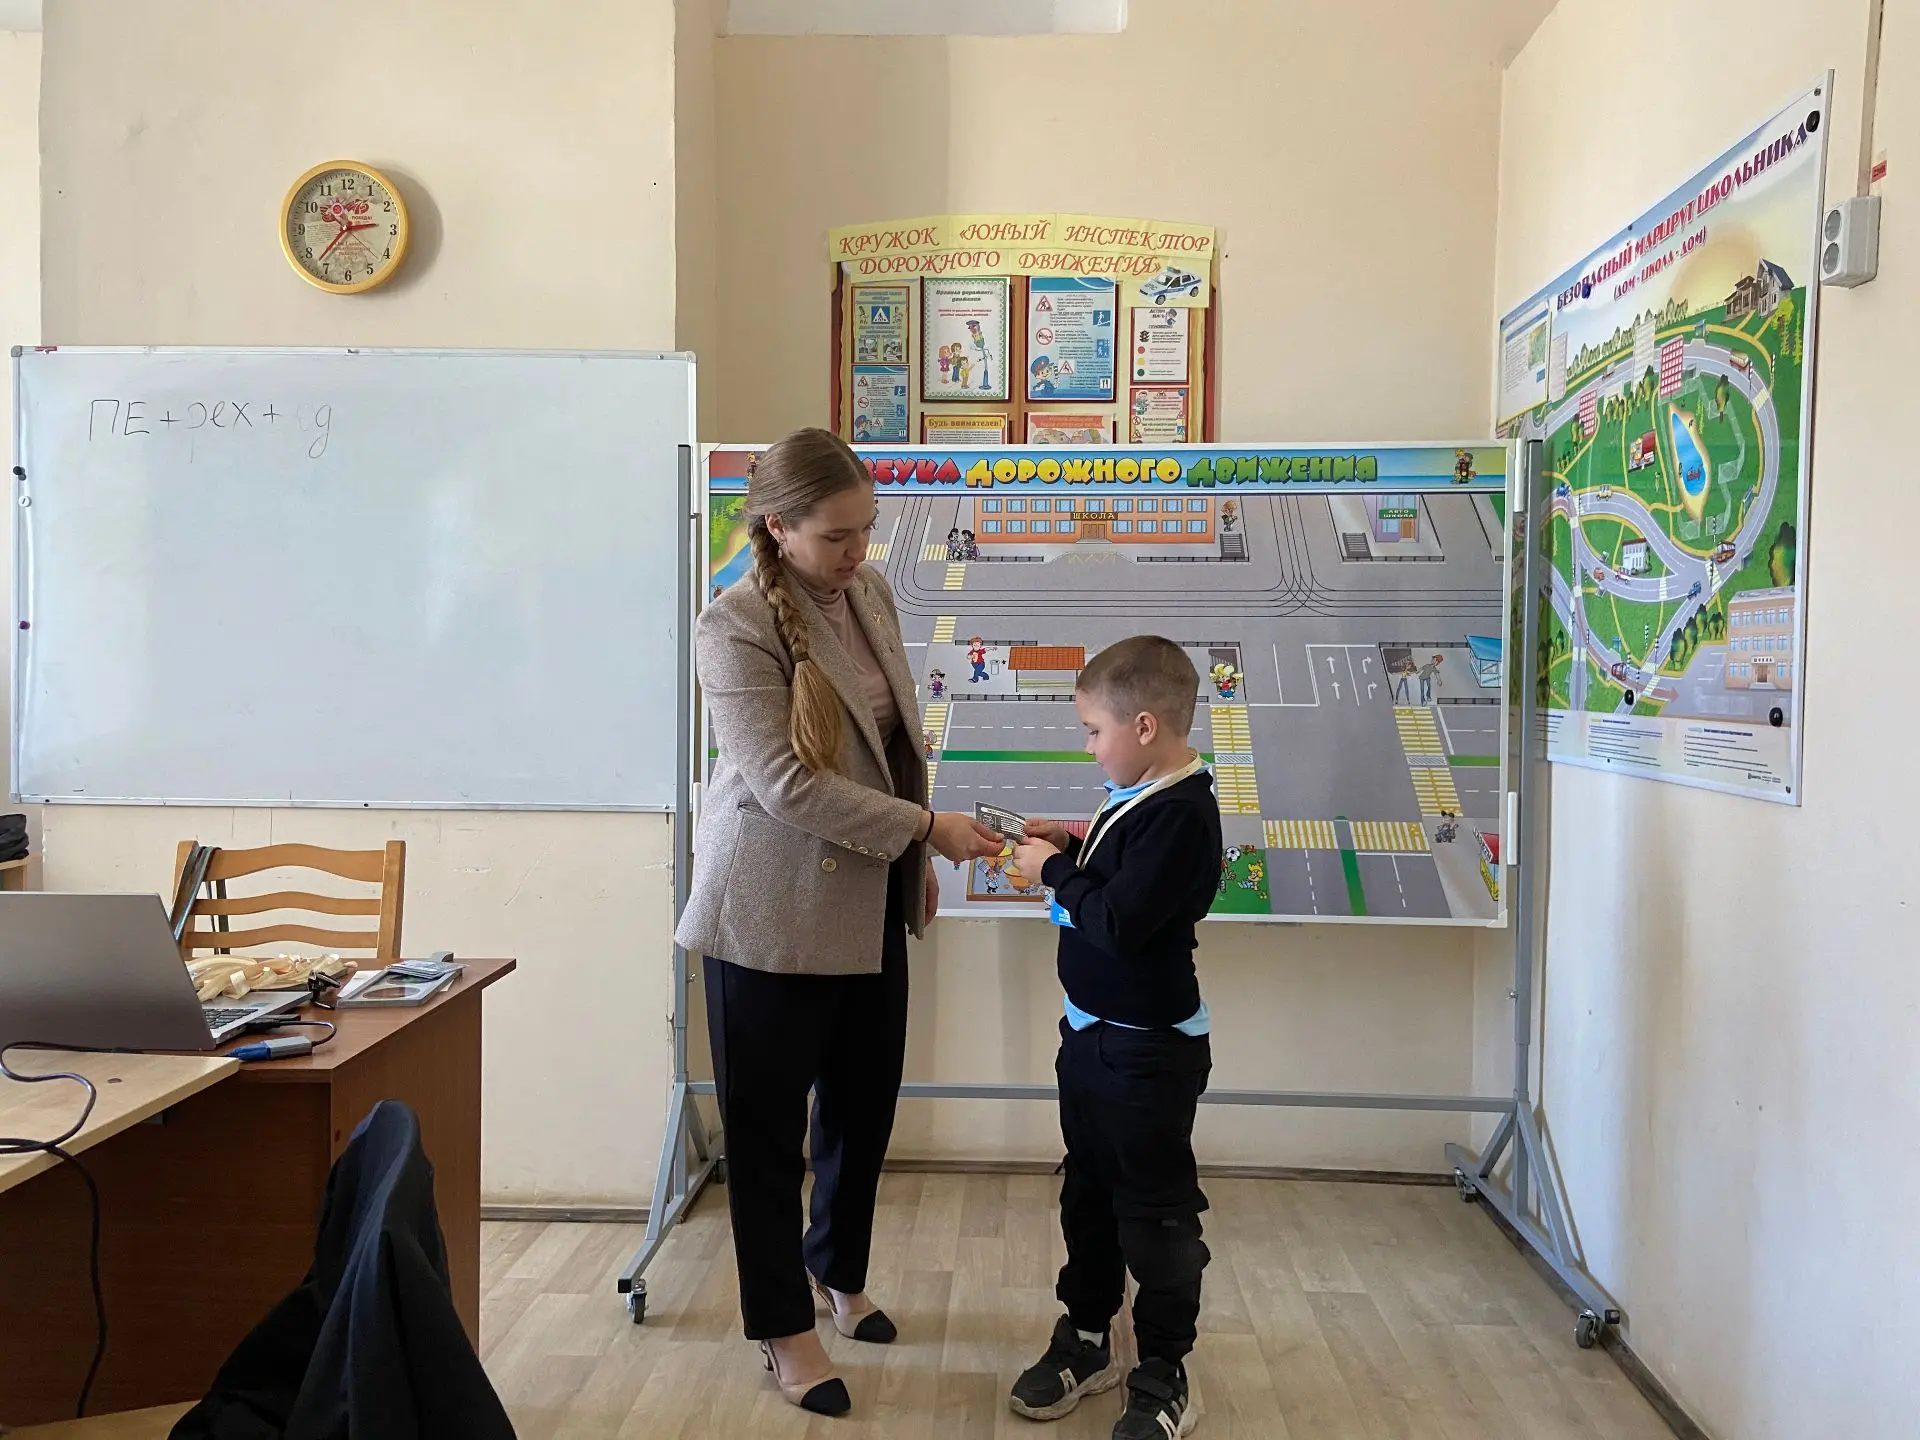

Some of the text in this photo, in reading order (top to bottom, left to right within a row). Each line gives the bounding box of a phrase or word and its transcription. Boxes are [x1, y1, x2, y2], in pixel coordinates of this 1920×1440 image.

[341, 179, 354, 190] 12
[1634, 200, 1695, 257] МАРШРУТ
[1697, 122, 1807, 216] ШКОЛЬНИКА
[320, 186, 333, 196] 11
[368, 185, 374, 196] 1
[304, 202, 318, 213] 10
[383, 201, 391, 212] 2
[298, 224, 305, 235] 9
[390, 224, 397, 236] 3
[839, 219, 1210, 255] КРУЖОК «ЮНЫЙ ИНСПЕКТОР
[305, 247, 313, 258] 8
[383, 248, 390, 259] 4
[323, 263, 330, 274] 7
[859, 250, 1161, 276] ДОРОЖНОГО ДВИЖЕНИЯ»
[366, 263, 374, 275] 5
[344, 270, 352, 281] 6
[929, 419, 1002, 428] Будь внимателен!
[965, 457, 1182, 487] ДОРОЖНОГО
[1187, 454, 1377, 488] ДВИЖЕНИЯ
[1073, 512, 1116, 520] ШКОЛА
